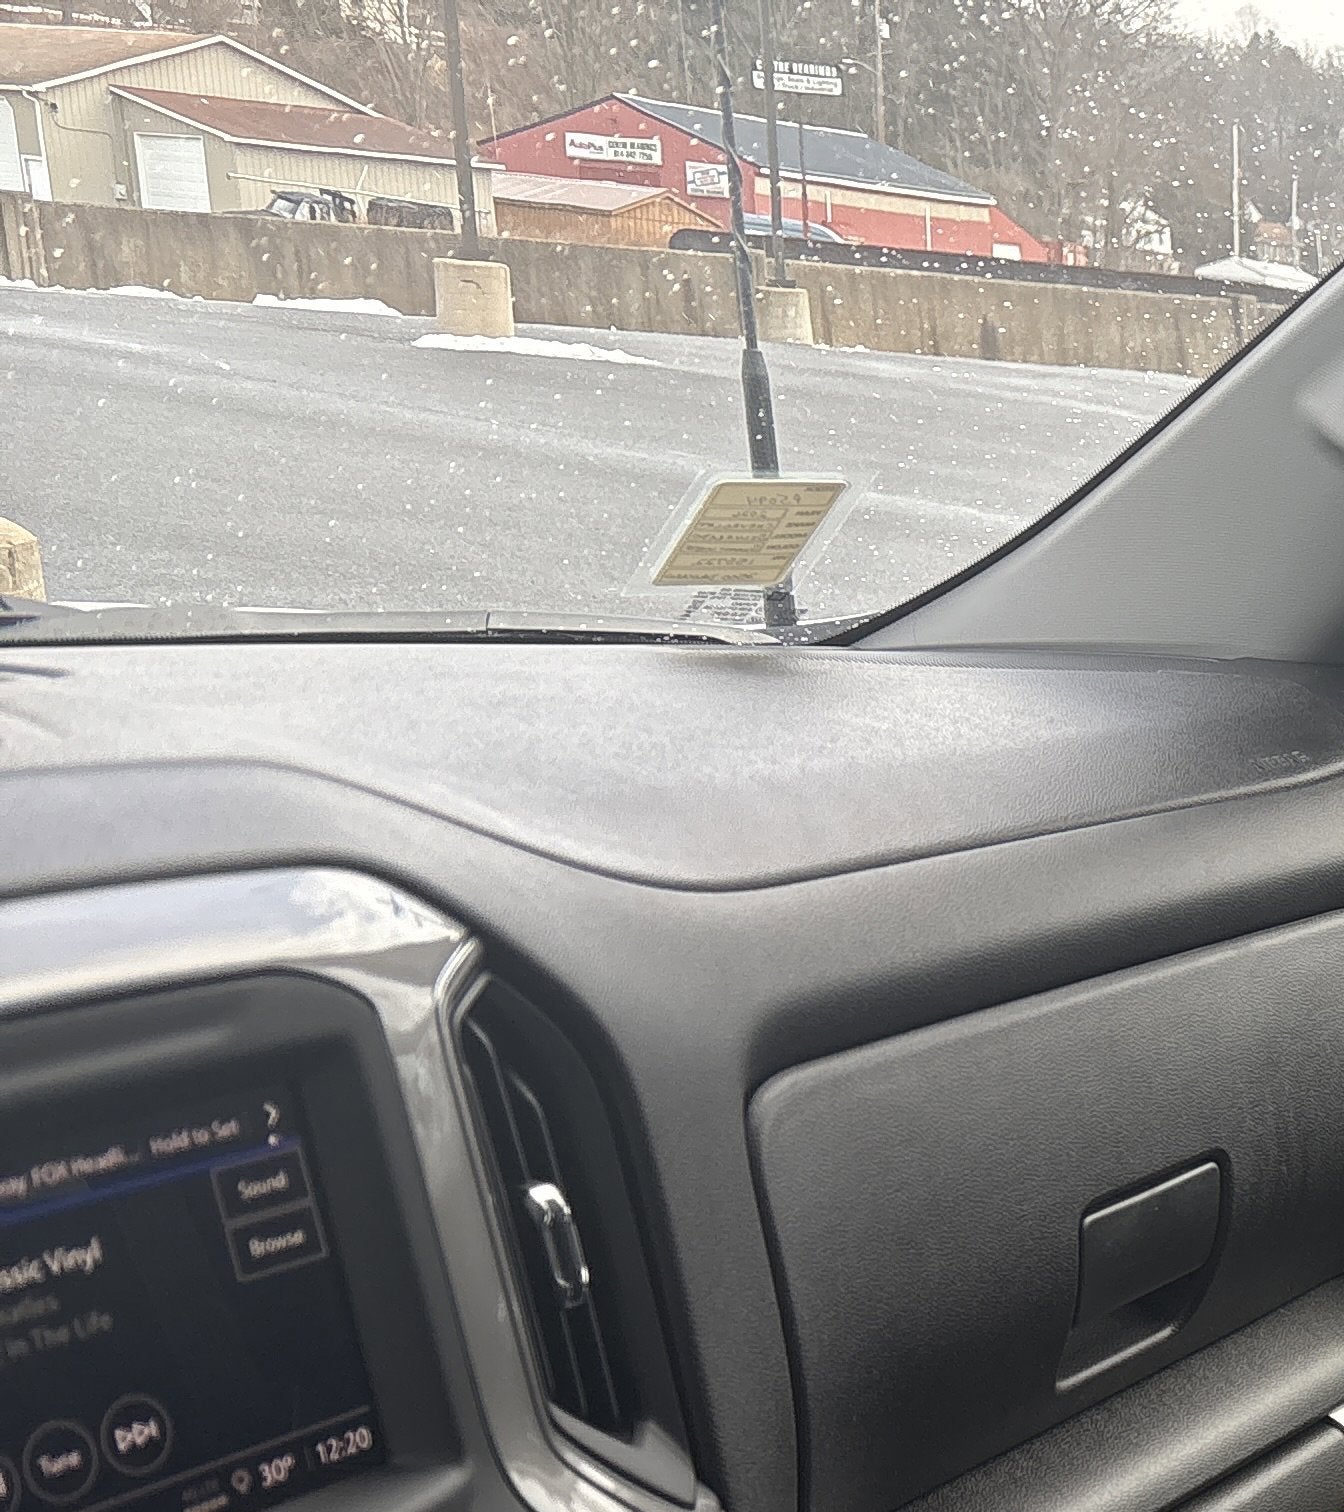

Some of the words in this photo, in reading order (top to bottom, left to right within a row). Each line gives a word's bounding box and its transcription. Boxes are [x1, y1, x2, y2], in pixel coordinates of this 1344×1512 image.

[756, 59, 790, 73] CTRE
[237, 1168, 290, 1202] Sound
[43, 1235, 104, 1276] Vinyl
[249, 1228, 308, 1259] Browse
[315, 1425, 374, 1465] 12:20
